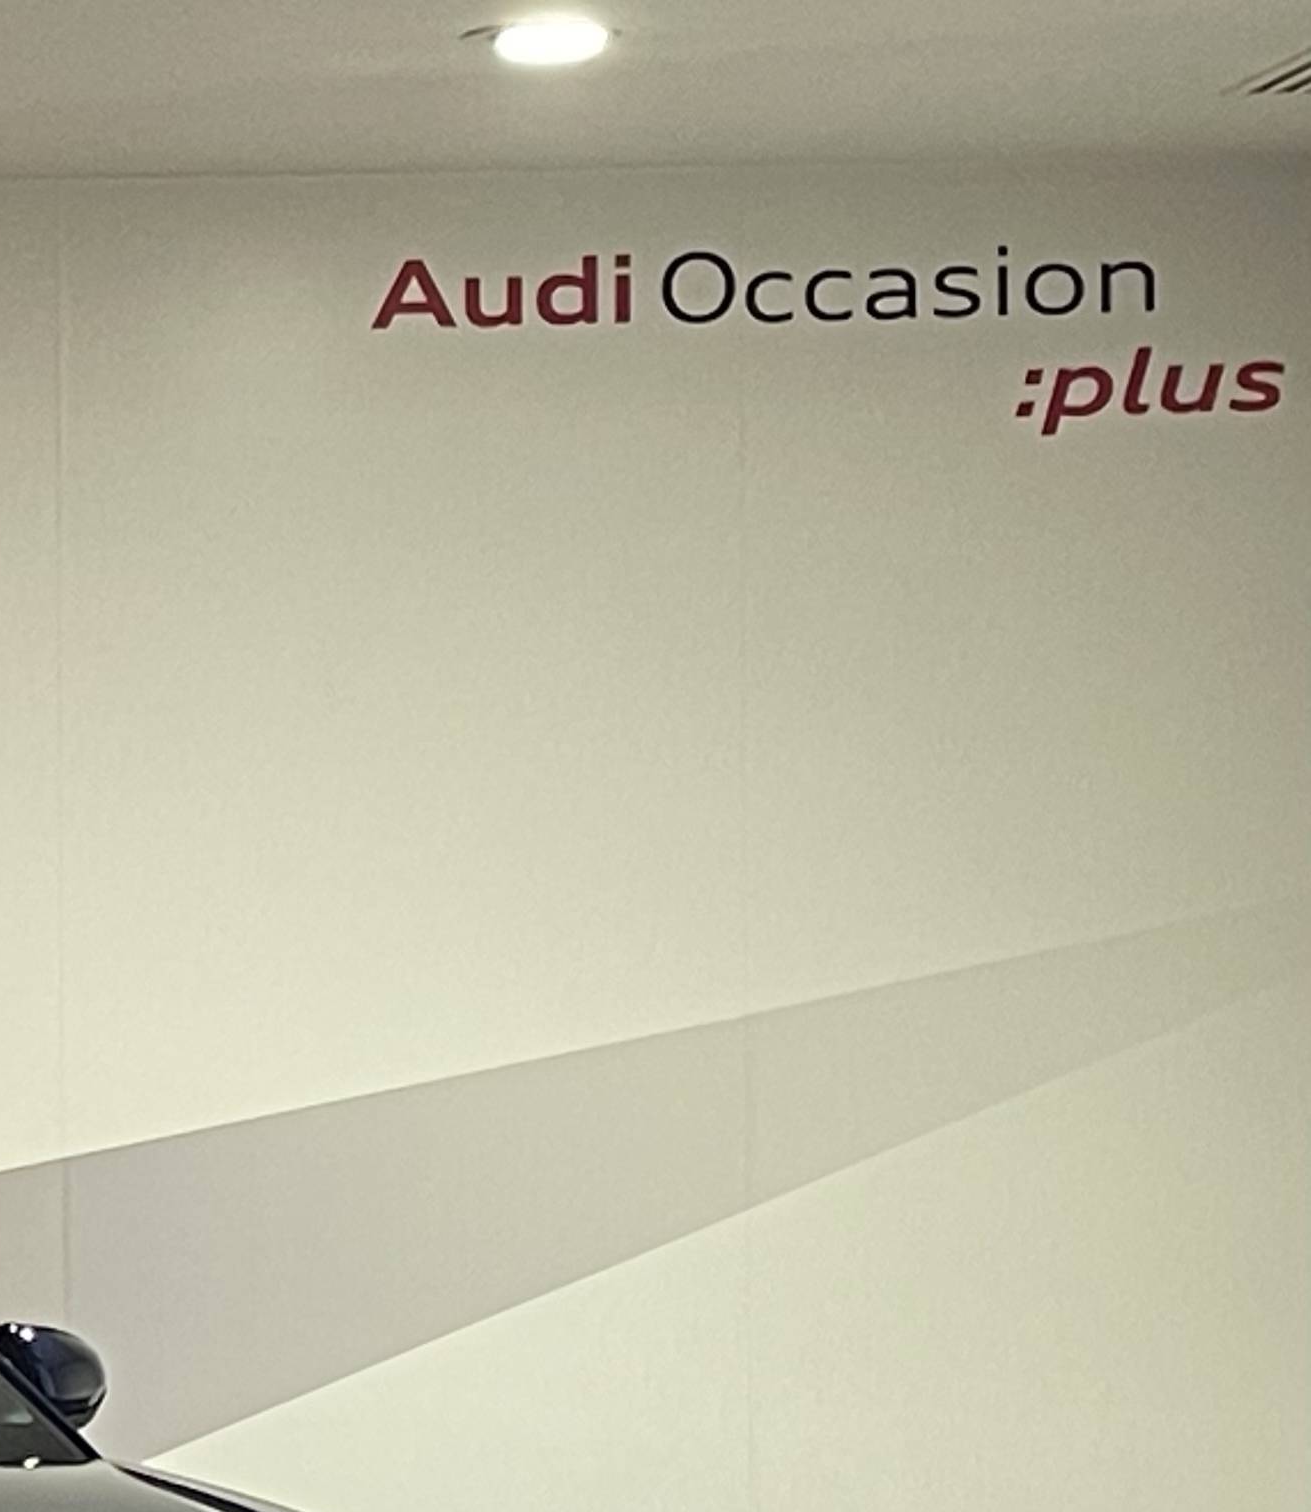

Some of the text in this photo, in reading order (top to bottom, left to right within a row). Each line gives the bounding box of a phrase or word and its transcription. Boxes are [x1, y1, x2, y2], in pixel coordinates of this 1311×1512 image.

[371, 245, 1158, 330] Audi Occasion
[1014, 347, 1285, 435] :plus
